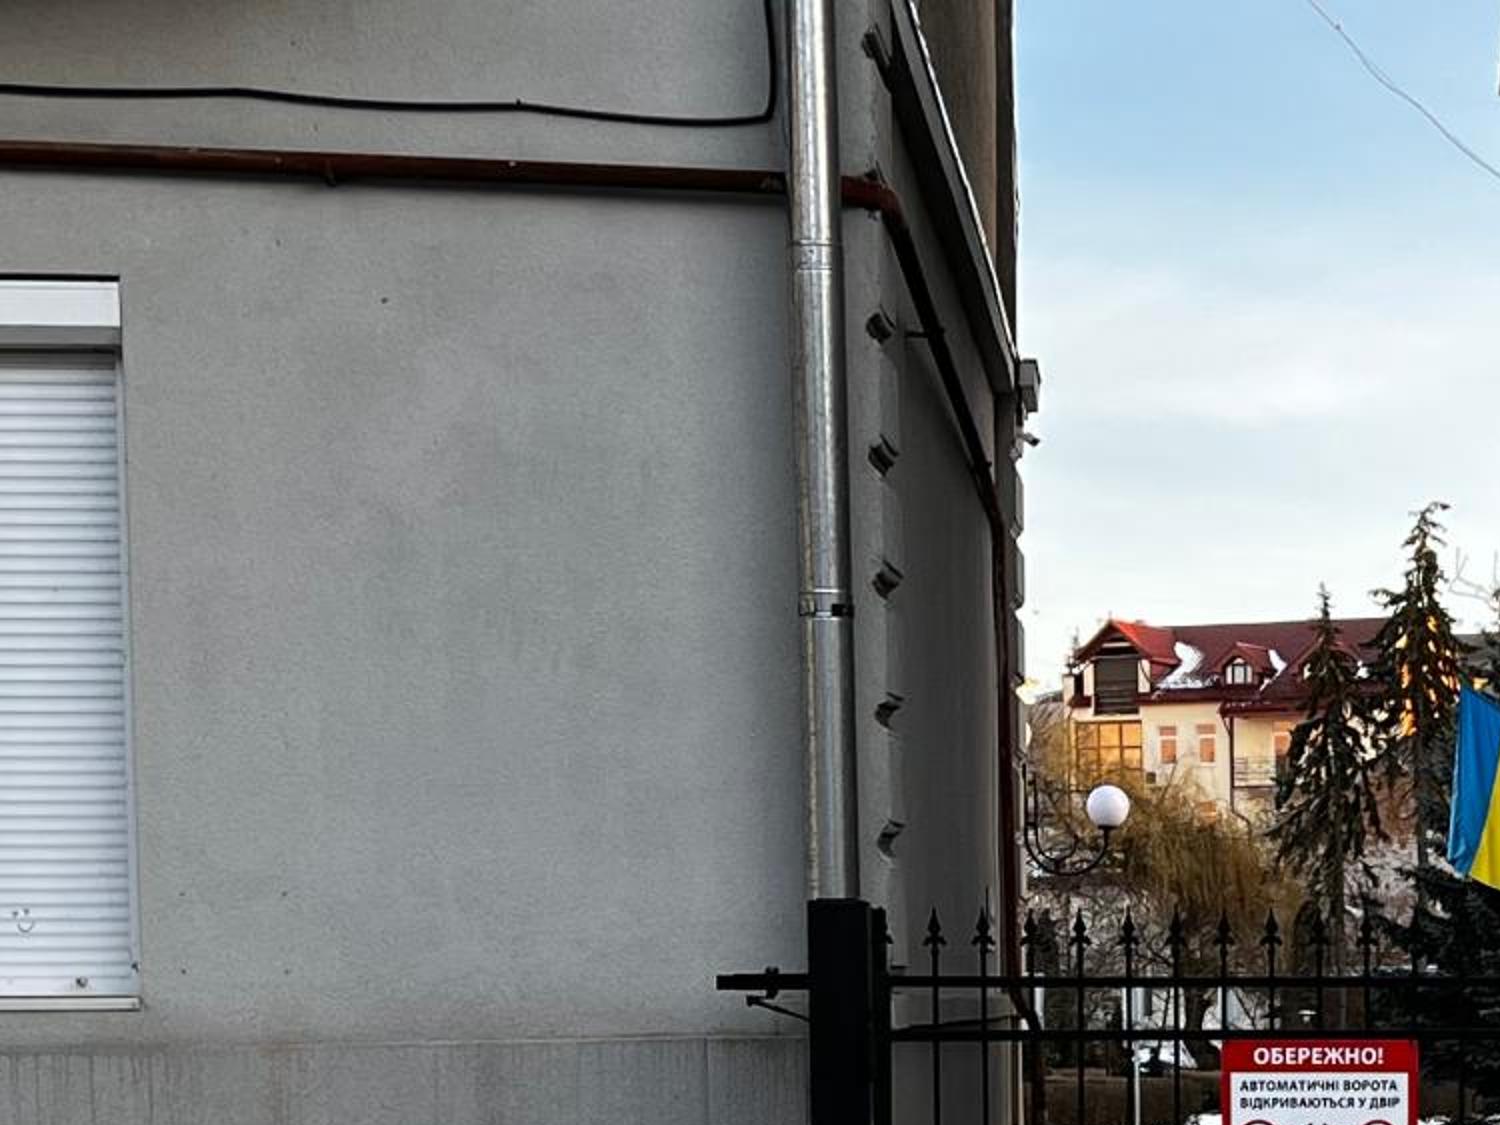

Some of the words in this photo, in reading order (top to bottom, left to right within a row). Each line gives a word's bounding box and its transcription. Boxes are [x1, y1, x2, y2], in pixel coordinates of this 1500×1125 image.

[1253, 1047, 1384, 1065] ОБЕРЕЖНО!
[1240, 1080, 1339, 1092] АВТОМАТИЧНІ
[1343, 1080, 1397, 1091] ВОРОТА
[1240, 1098, 1354, 1109] ВІДКРИВАЮТЬСЯ
[1358, 1098, 1366, 1109] У
[1369, 1098, 1400, 1109] ДВІР
